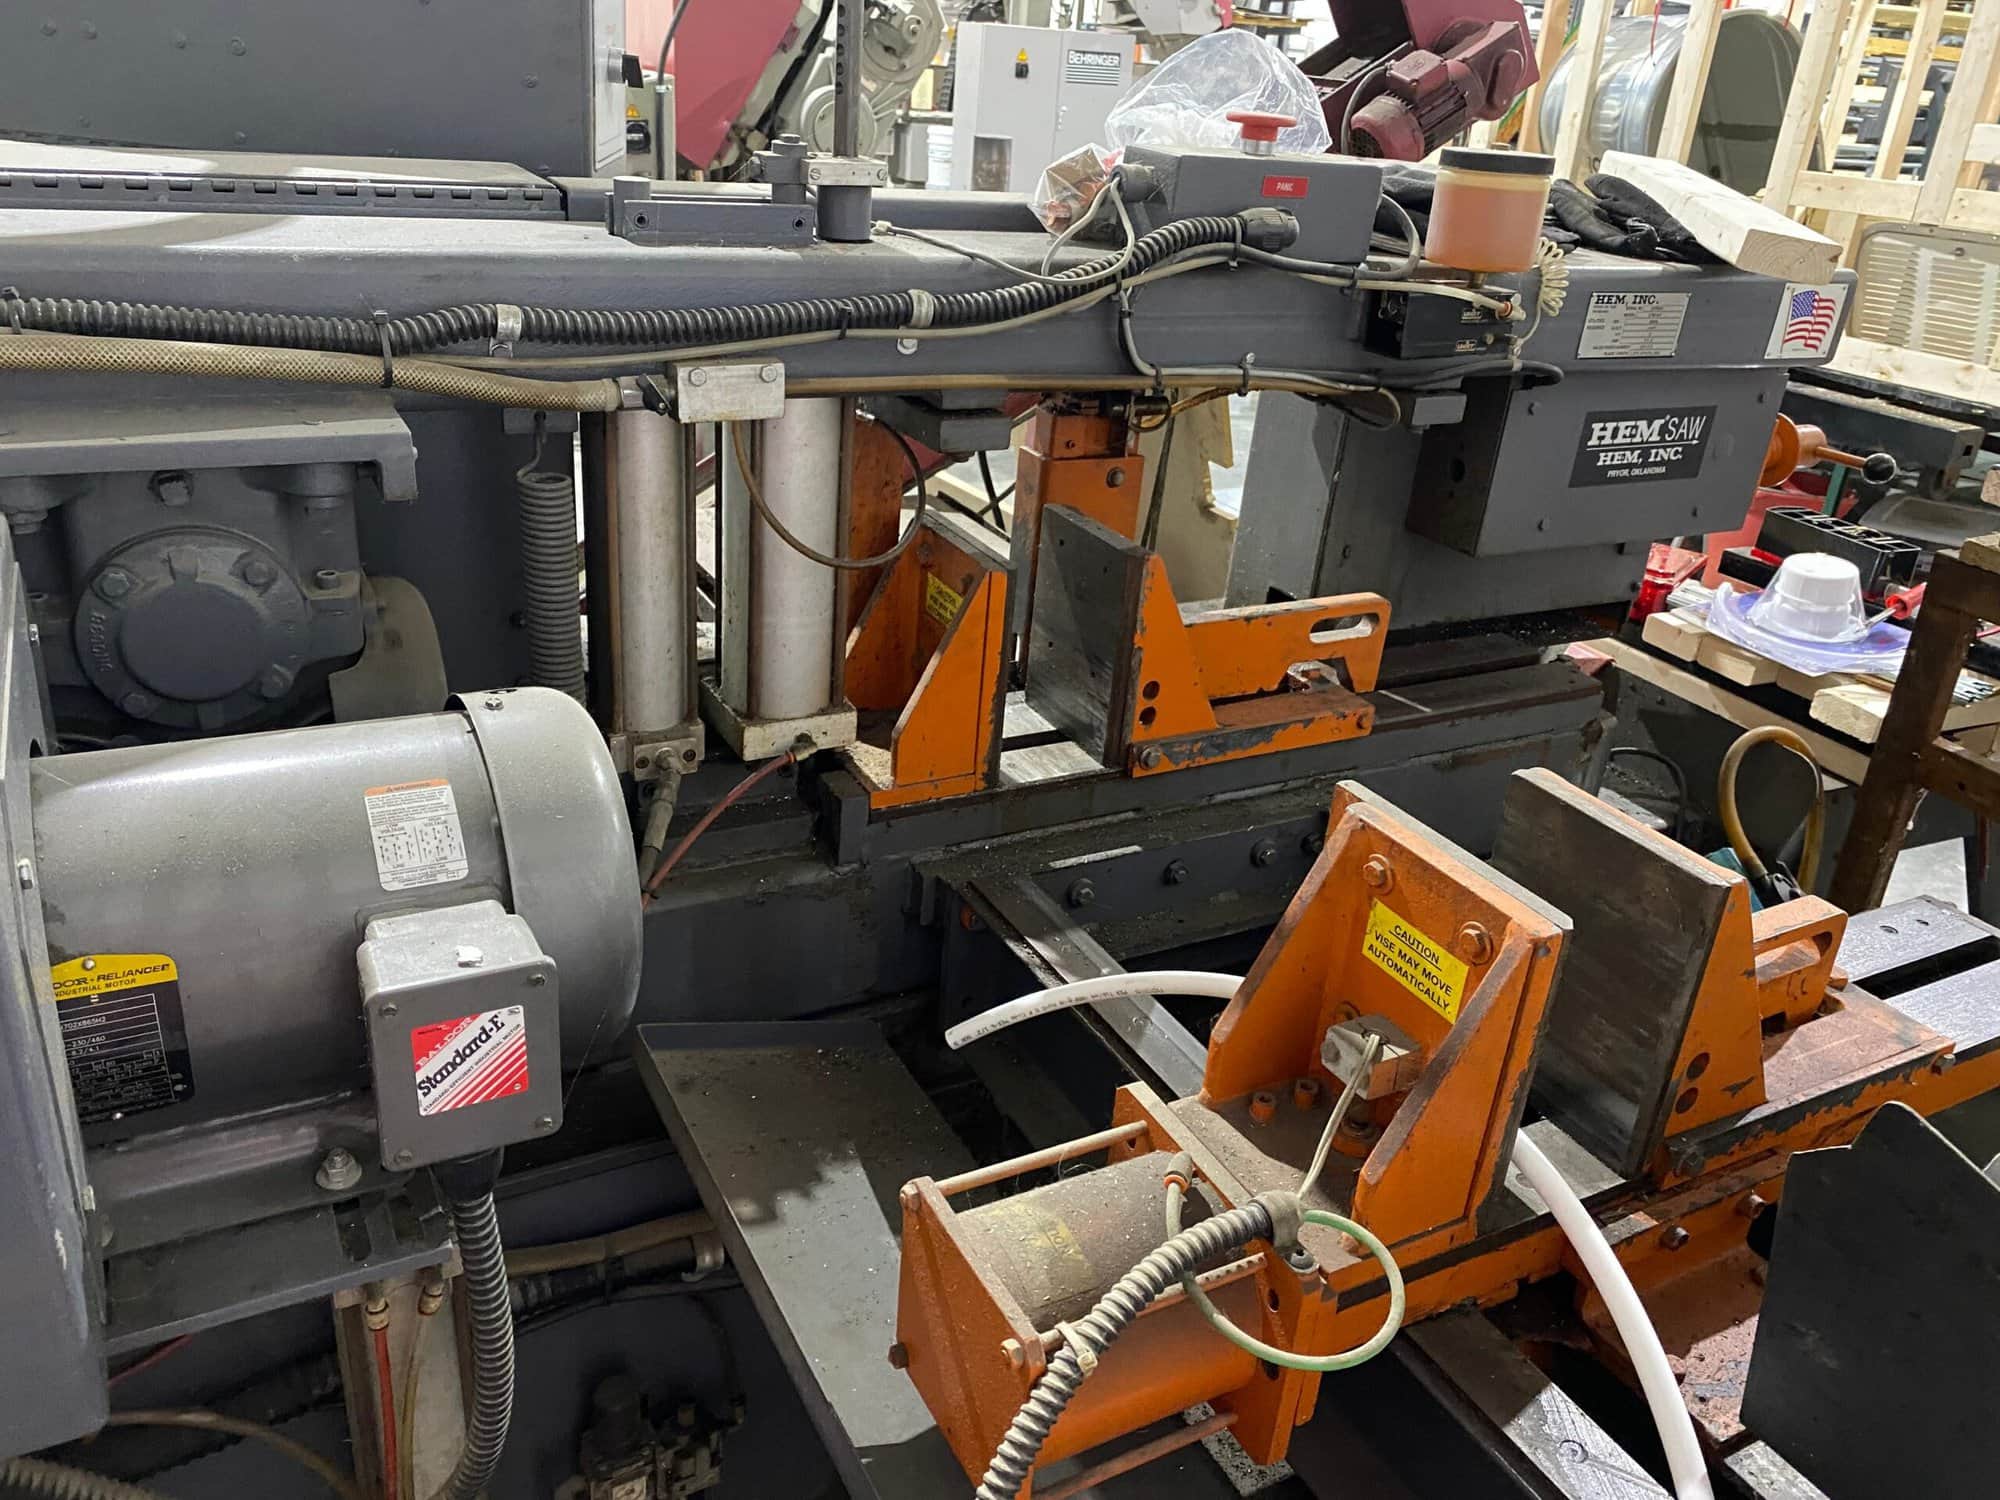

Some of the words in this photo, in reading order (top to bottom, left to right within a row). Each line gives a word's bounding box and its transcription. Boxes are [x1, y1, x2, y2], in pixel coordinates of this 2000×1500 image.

[1069, 51, 1119, 66] BEHRINGER
[1594, 295, 1628, 306] HEM,
[1631, 295, 1660, 305] INC.
[1587, 419, 1665, 446] HEM
[1665, 415, 1706, 441] SAW
[1596, 450, 1642, 466] HEM,
[1631, 466, 1666, 476] OKLAHOMA
[1394, 924, 1440, 965] CAUTION
[1375, 930, 1396, 953] VISE
[1398, 949, 1420, 970] MAY
[1422, 967, 1453, 997] MOVE
[105, 978, 137, 988] MOTOR
[1367, 943, 1452, 1014] AUTOMATICALLY.
[415, 1016, 473, 1067] BALDOR
[502, 1023, 521, 1041] MOTOR
[417, 1014, 505, 1098] Standard-E
